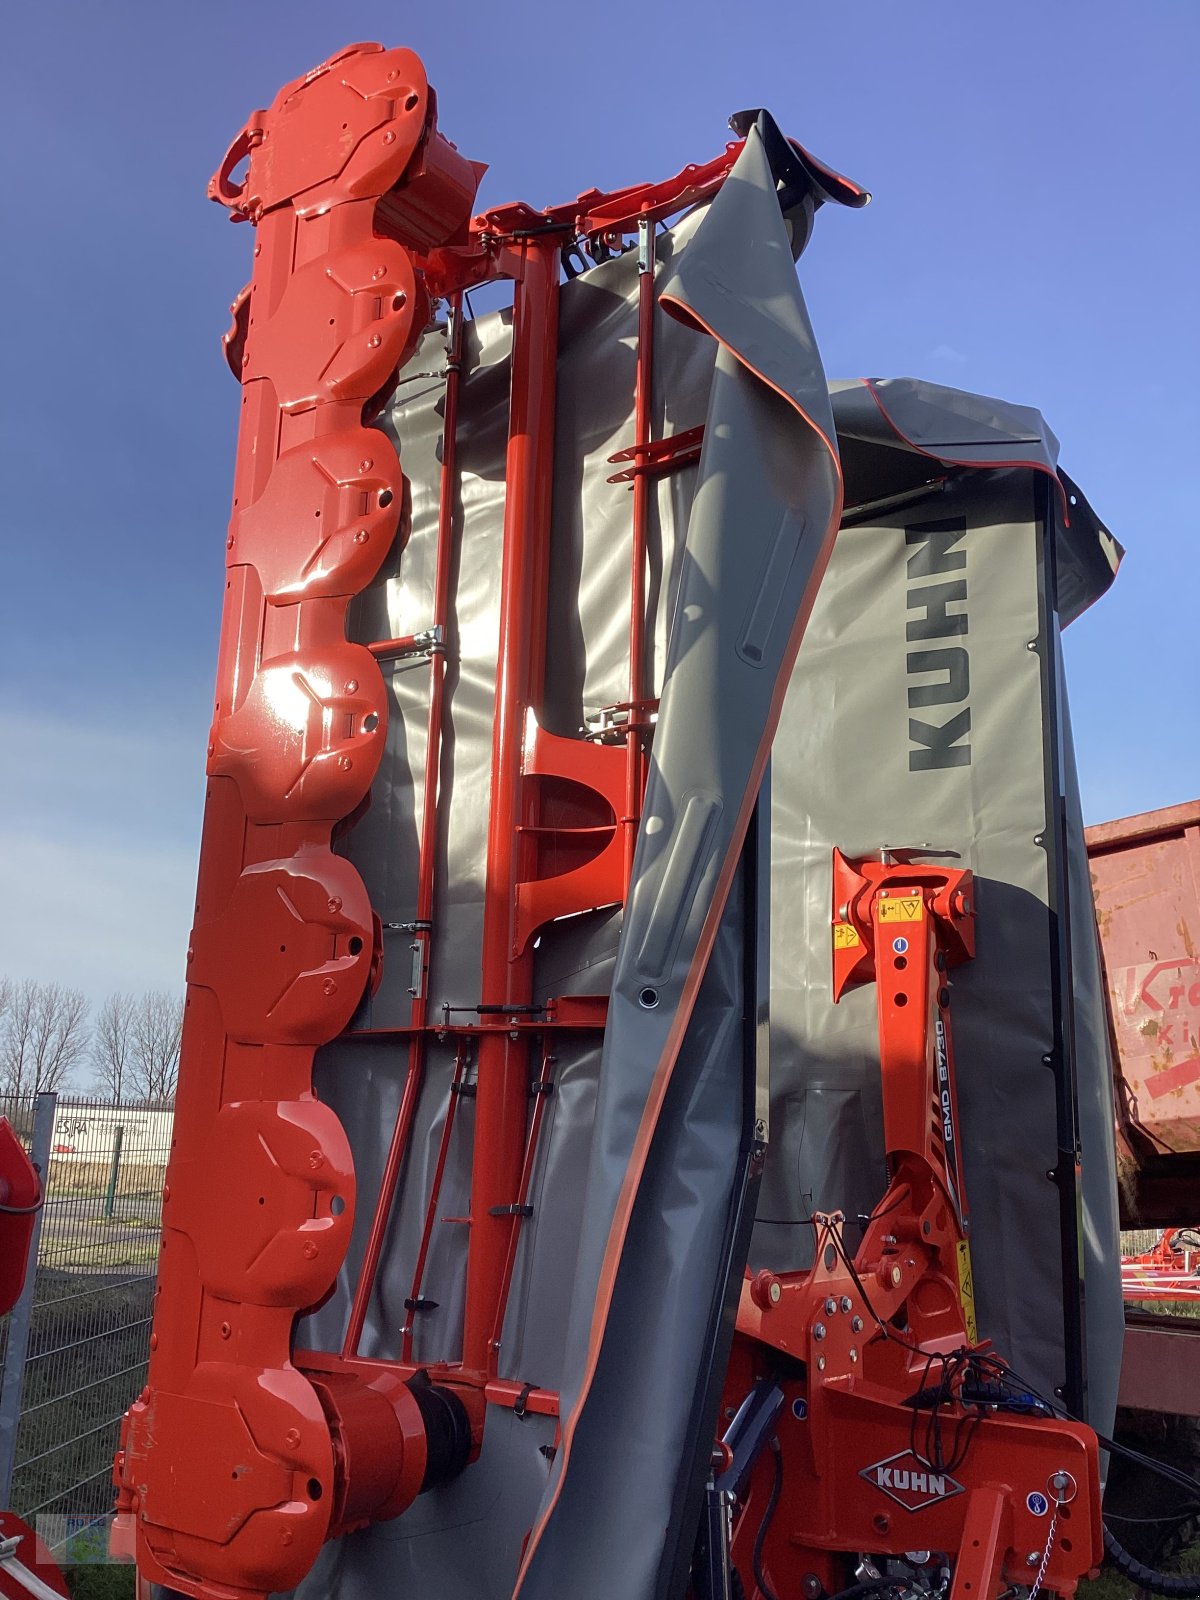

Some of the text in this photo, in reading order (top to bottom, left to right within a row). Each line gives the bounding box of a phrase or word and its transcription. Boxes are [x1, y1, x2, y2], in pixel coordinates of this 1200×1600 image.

[905, 515, 972, 772] KUHN
[935, 1020, 953, 1142] GMD 8730
[877, 1466, 946, 1496] KUHN
